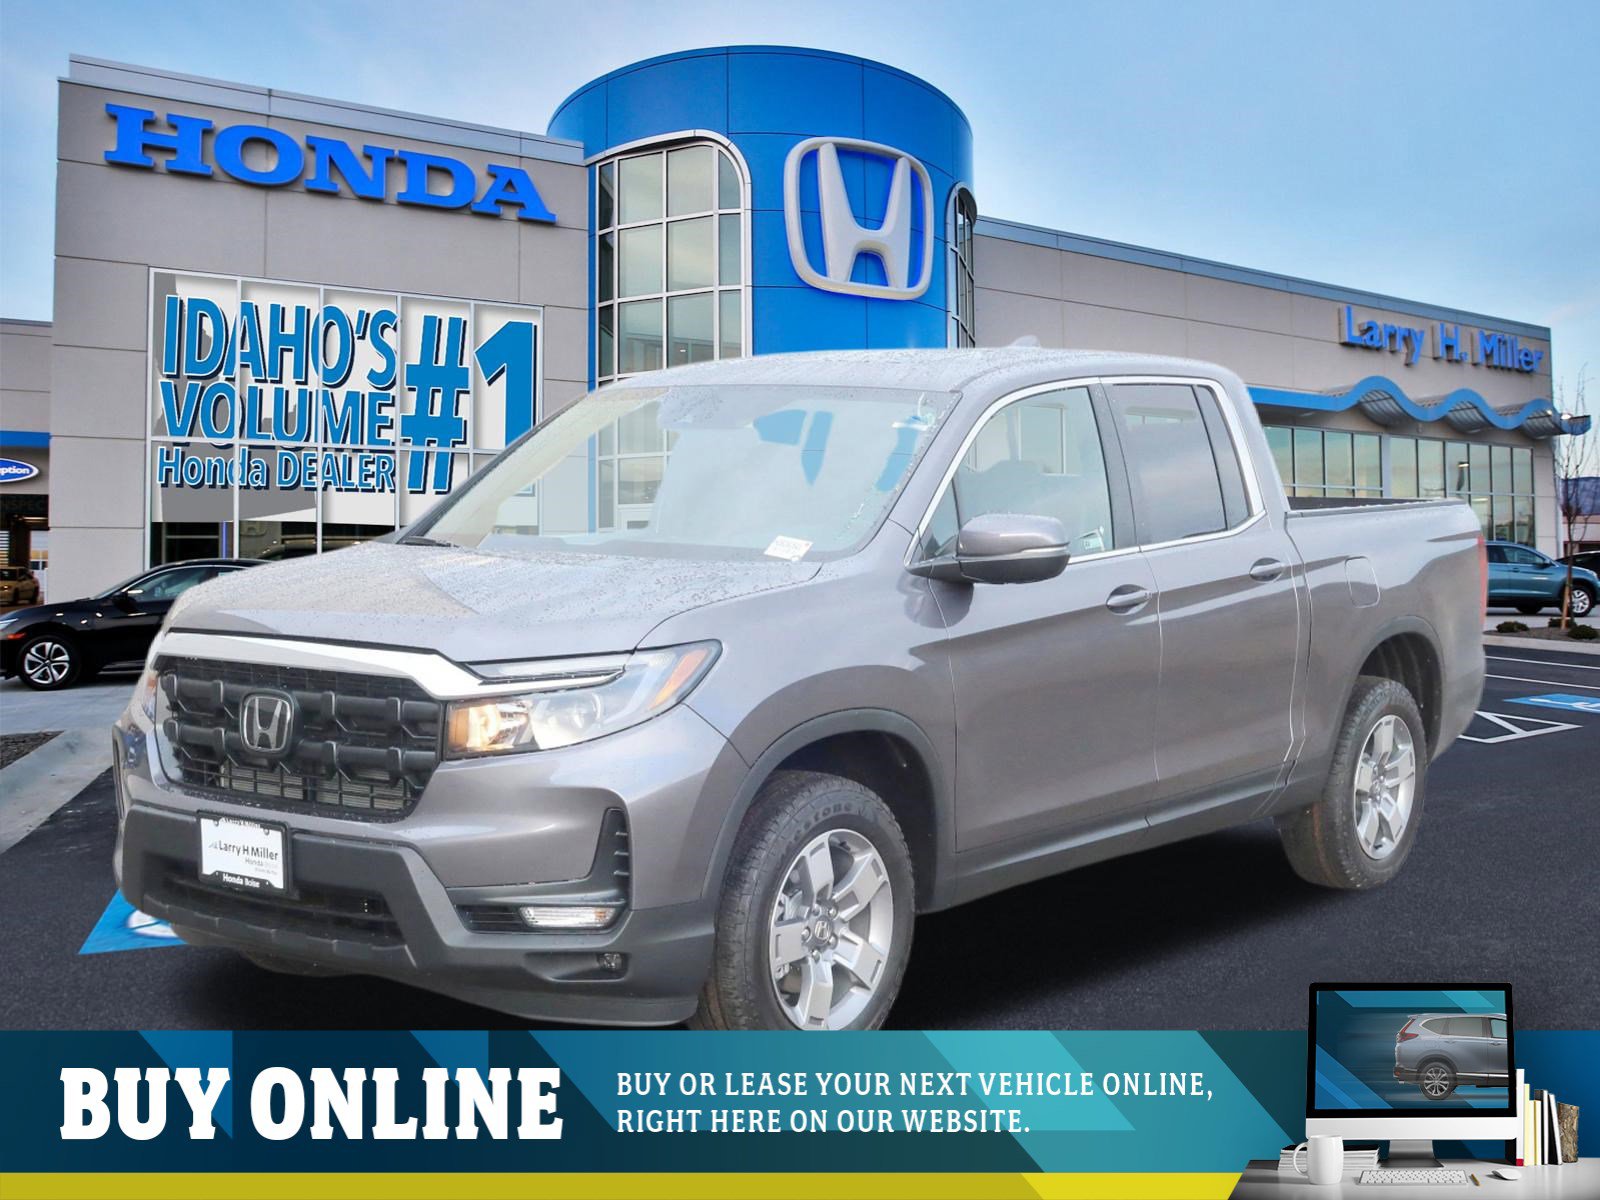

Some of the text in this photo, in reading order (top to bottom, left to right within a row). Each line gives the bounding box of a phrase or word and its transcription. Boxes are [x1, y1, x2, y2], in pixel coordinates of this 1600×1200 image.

[104, 102, 557, 224] HONDA
[162, 294, 399, 389] IDAHO'S
[1341, 304, 1545, 374] Larry H. Miller
[158, 380, 398, 449] VOLUME
[400, 314, 539, 496] #1
[0, 465, 30, 476] ption
[157, 446, 397, 493] Honda DEALER
[219, 840, 278, 860] Larry H Miller
[222, 873, 243, 886] Honda
